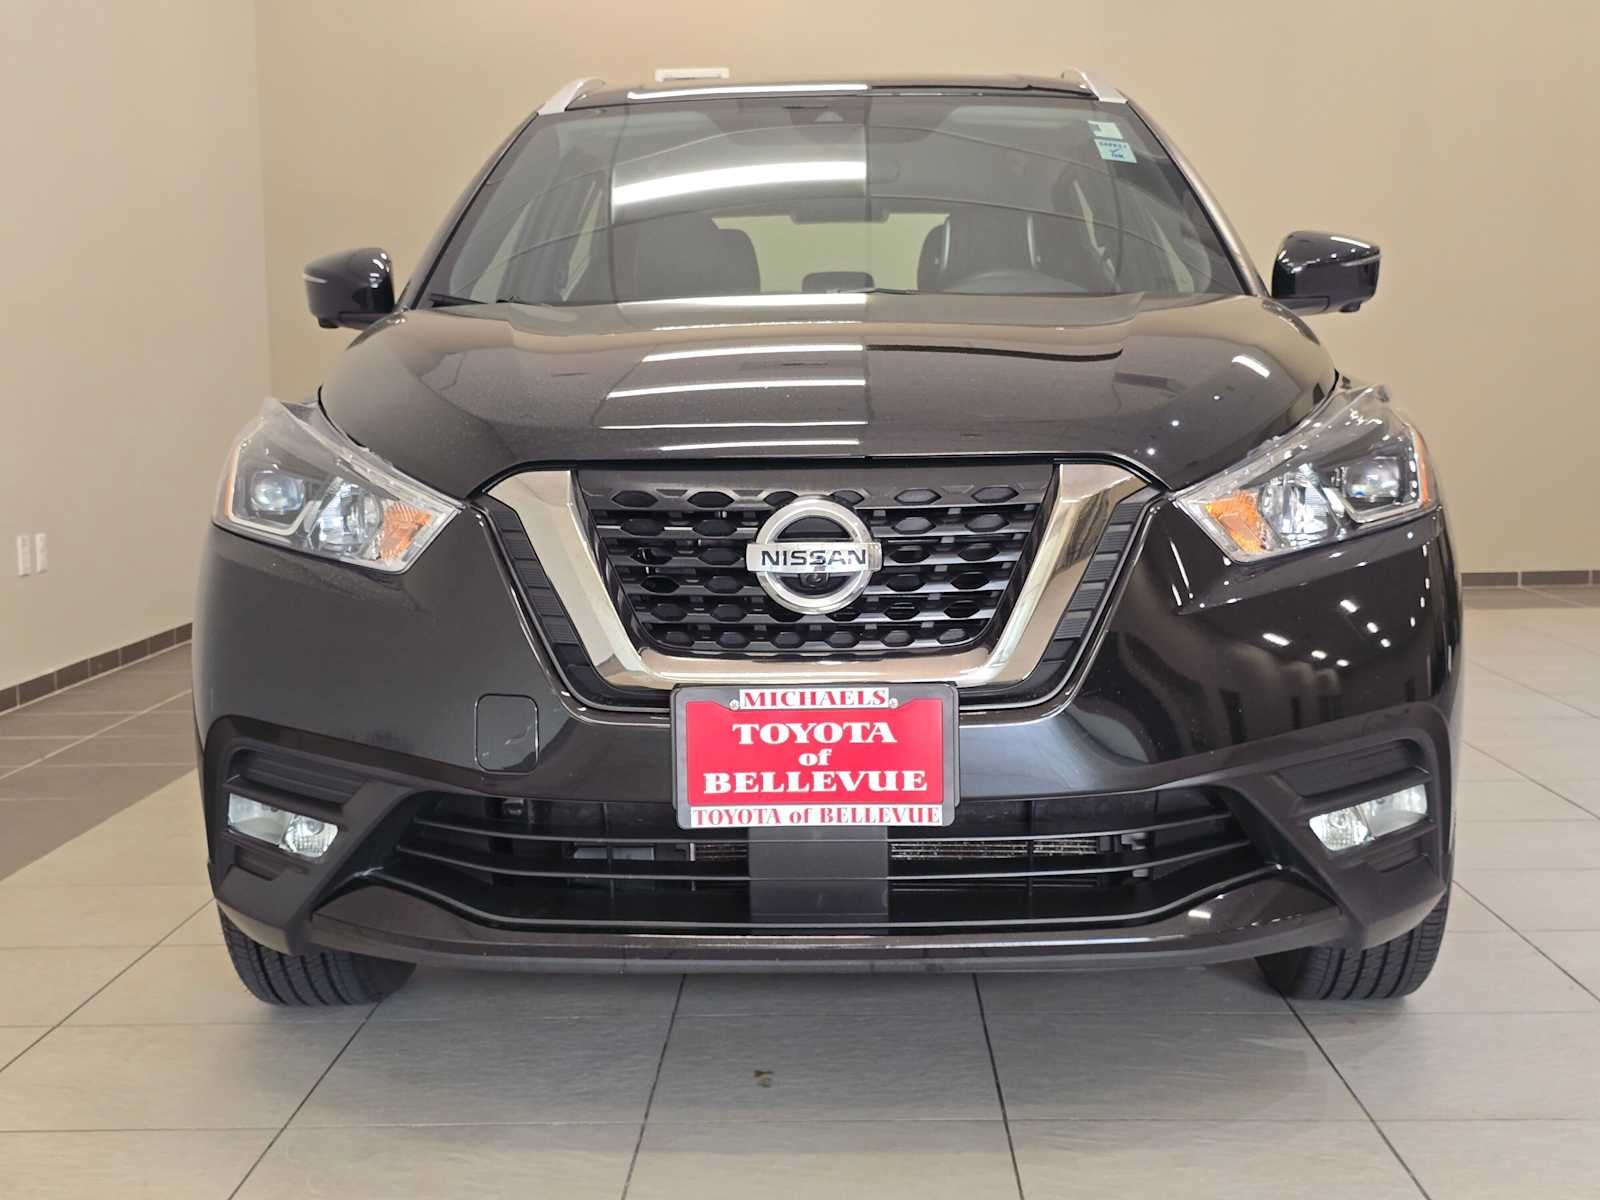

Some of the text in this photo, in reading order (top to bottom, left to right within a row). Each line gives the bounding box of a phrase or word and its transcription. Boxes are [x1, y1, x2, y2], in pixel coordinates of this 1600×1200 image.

[761, 550, 866, 565] NISSAN
[744, 689, 886, 707] MICHAELS
[732, 722, 897, 745] TOYOTA
[798, 749, 832, 766] of
[703, 770, 928, 794] BELLEVUE
[693, 806, 940, 825] TOYOTA of BELLEVUE
